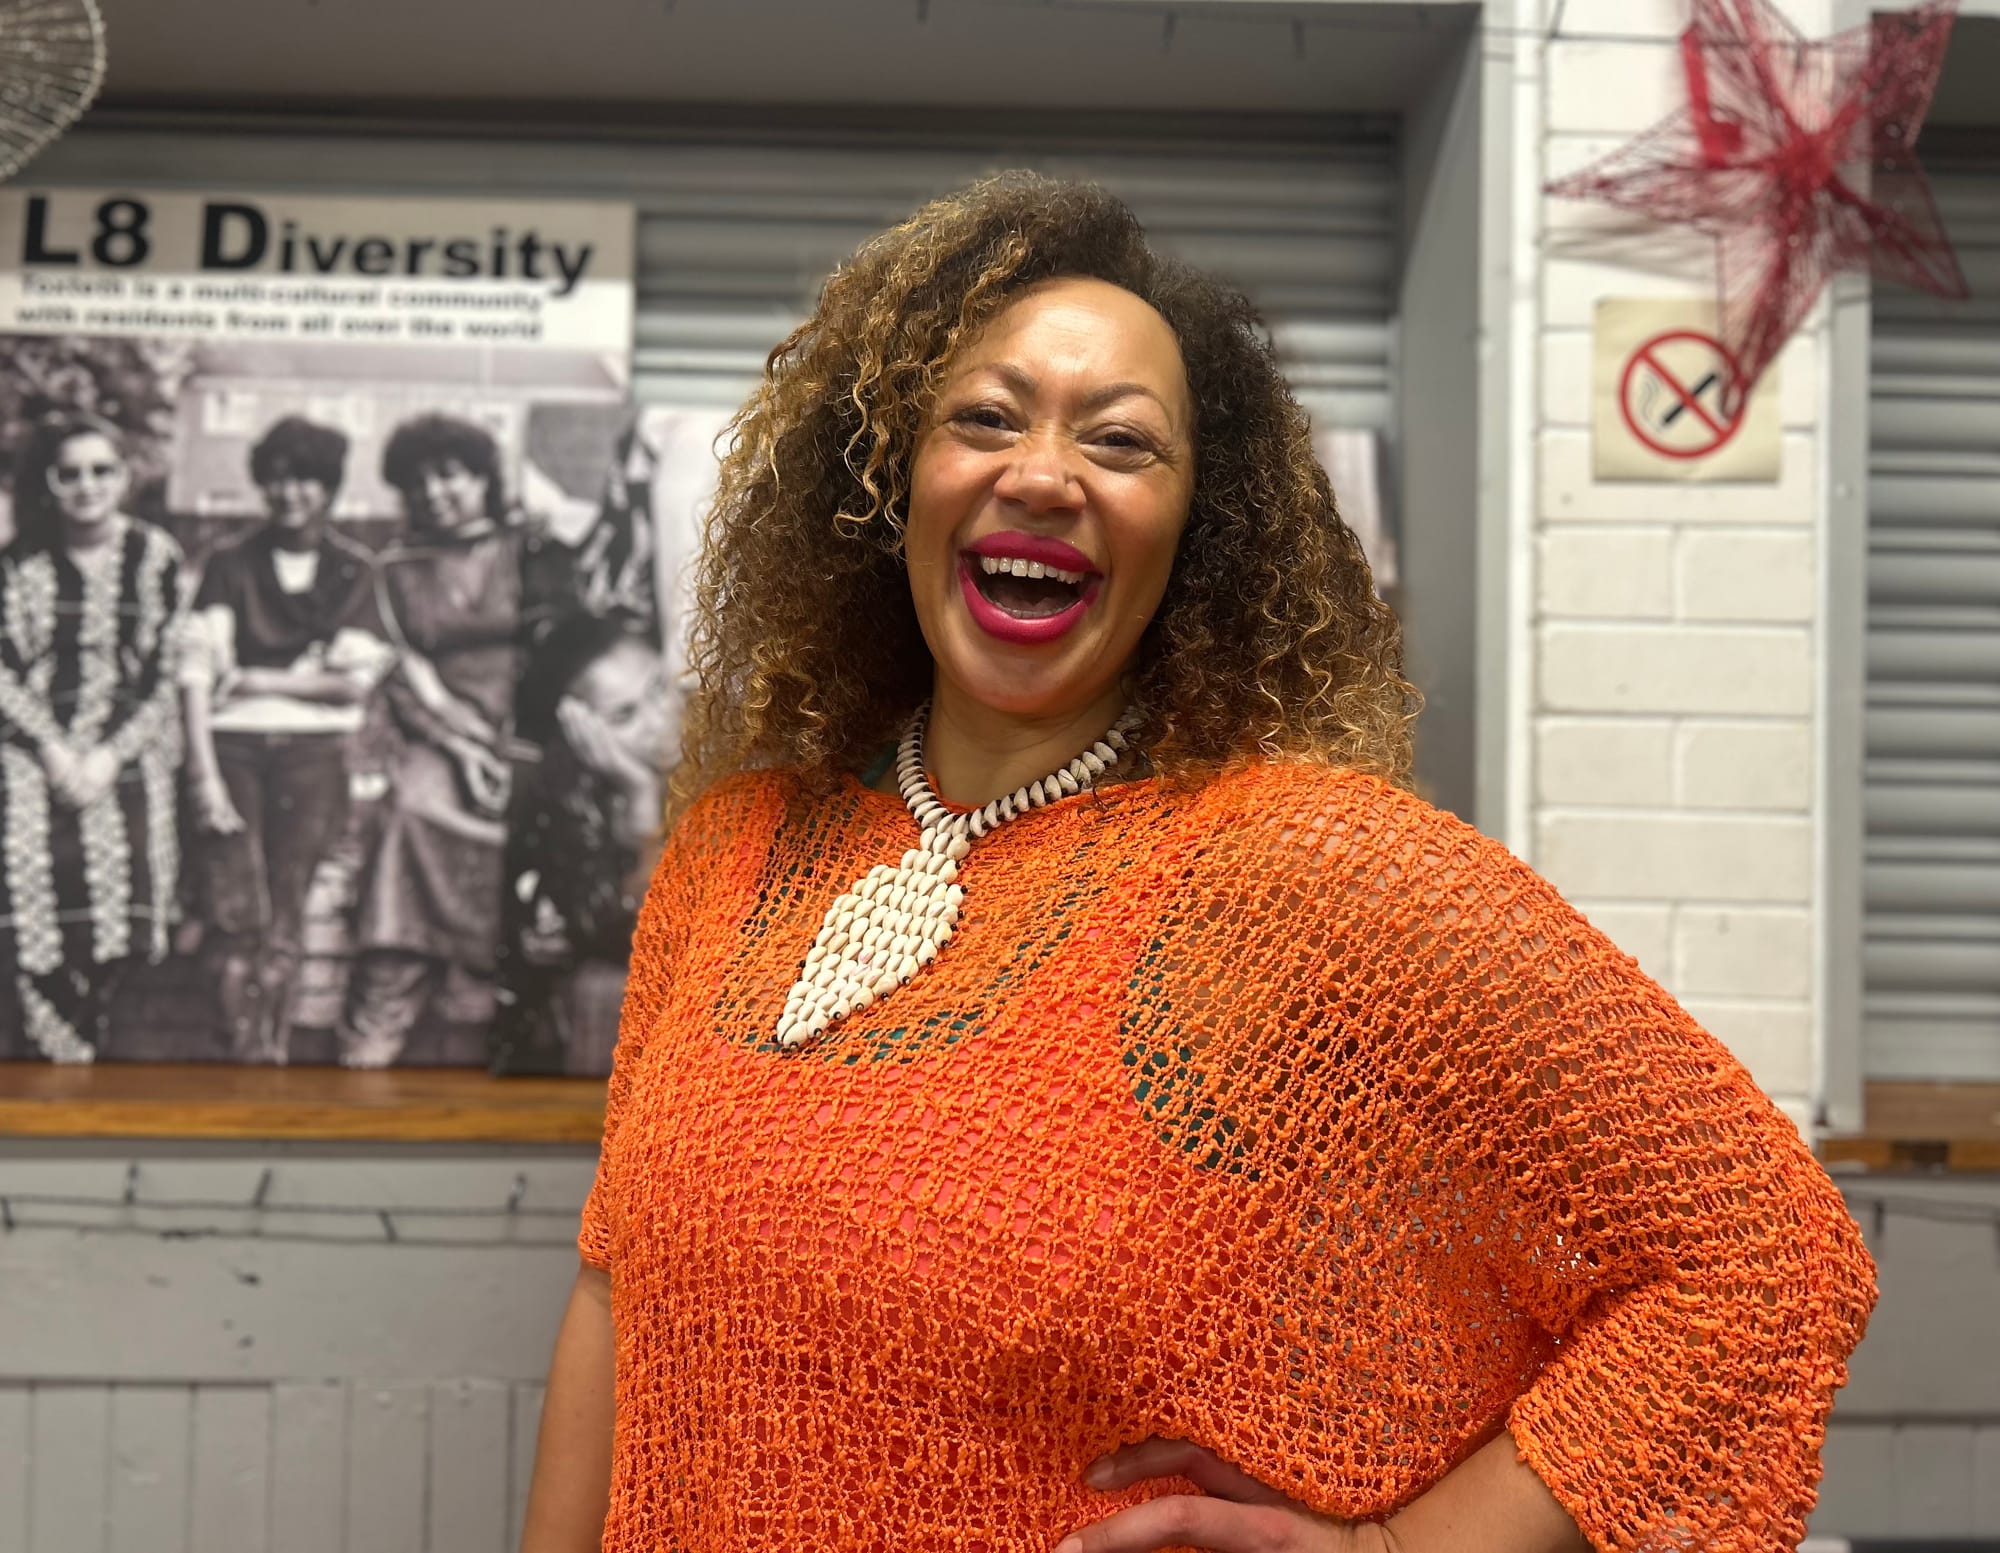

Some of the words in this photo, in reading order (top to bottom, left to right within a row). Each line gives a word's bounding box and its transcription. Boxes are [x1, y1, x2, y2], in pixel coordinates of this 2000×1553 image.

[22, 194, 151, 269] L8
[200, 202, 594, 297] Diversity
[135, 277, 155, 298] is
[168, 283, 184, 299] a
[388, 288, 541, 312] community
[17, 305, 75, 323] with
[85, 307, 215, 328] residents
[225, 310, 289, 330] from
[342, 318, 400, 333] over
[409, 315, 454, 335] the
[463, 317, 542, 337] world
